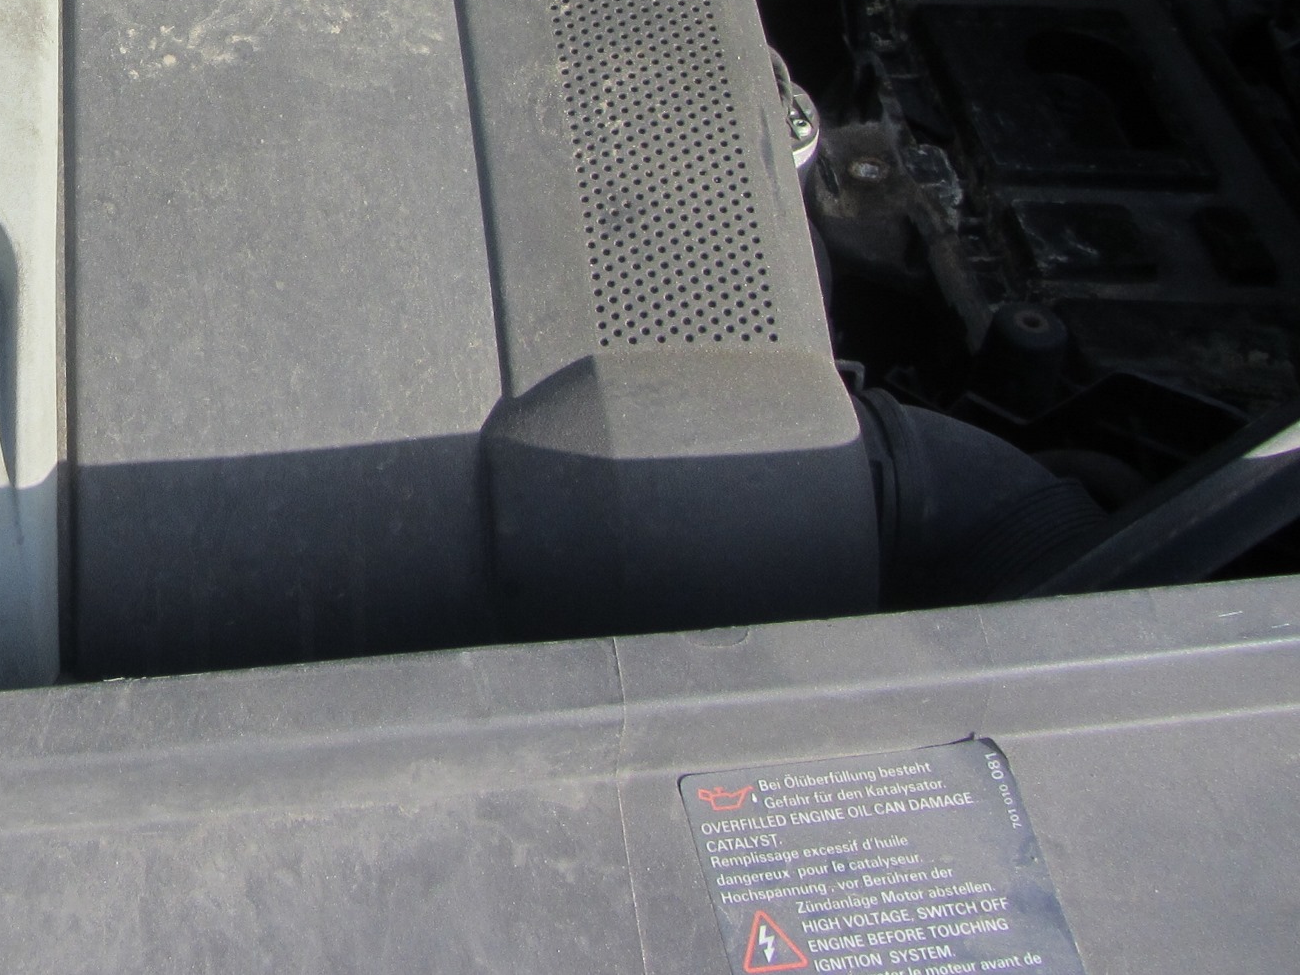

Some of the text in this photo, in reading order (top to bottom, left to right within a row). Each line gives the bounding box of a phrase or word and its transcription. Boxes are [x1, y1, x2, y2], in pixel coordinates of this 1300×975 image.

[758, 761, 932, 792] Bei Ölüberfüllung besteht
[764, 779, 947, 809] Gefahr für den Katalysator.
[701, 792, 974, 835] OVERFILLED ENGINE OIL CAN DAMAGE
[706, 833, 782, 853] CATALYST.
[710, 849, 799, 869] Remplissage
[803, 839, 858, 858] excessif
[716, 853, 923, 887] dangereux pour le catalyseur.
[837, 879, 860, 891] vor
[862, 870, 928, 888] Berühren
[930, 866, 954, 879] der
[796, 881, 996, 914] Zündanlage Motor abstellen.
[801, 916, 842, 933] HIGH
[916, 901, 978, 920] SWITCH
[980, 897, 1009, 913] OFF
[807, 917, 1009, 953] ENGINE BEFORE TOUCHING
[814, 945, 956, 972] IGNITION SYSTEM.
[925, 961, 976, 975] moteur
[980, 955, 1020, 971] avant
[1024, 951, 1042, 966] de
